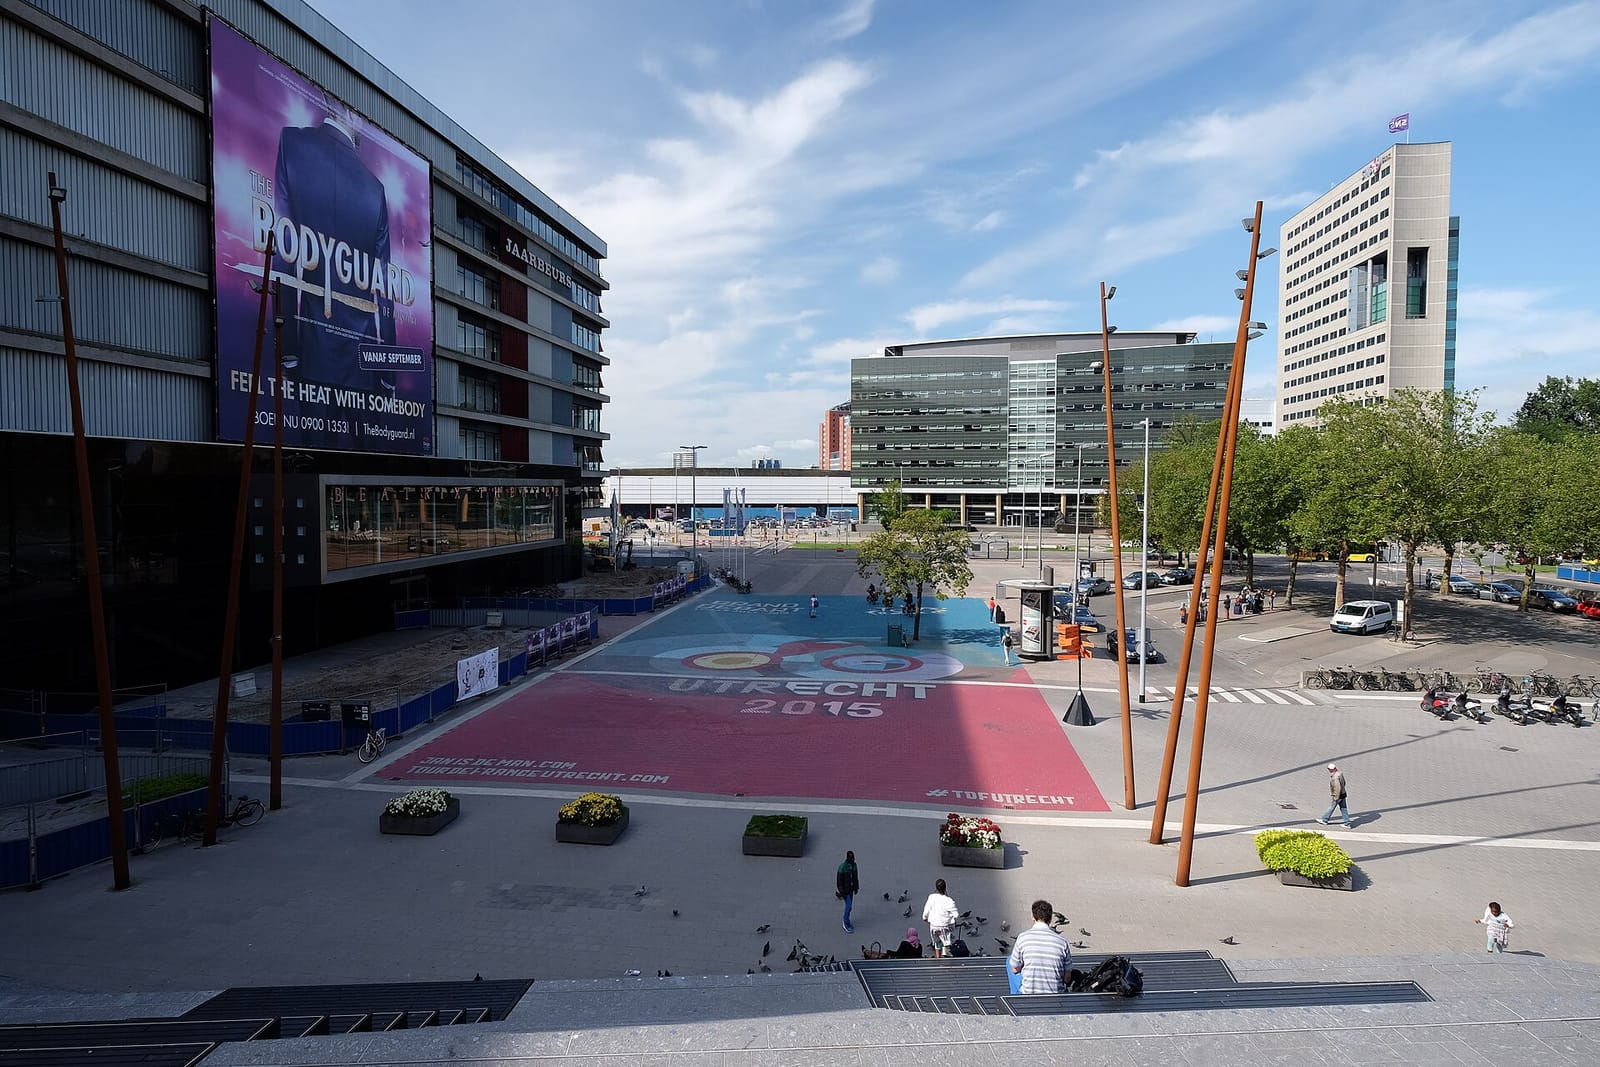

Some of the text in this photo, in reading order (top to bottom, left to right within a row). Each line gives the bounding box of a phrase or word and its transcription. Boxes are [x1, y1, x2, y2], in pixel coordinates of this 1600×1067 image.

[249, 170, 273, 199] THE
[252, 196, 416, 319] BODYGUARD
[505, 238, 573, 289] JAARBEURS
[362, 351, 422, 364] VANAF SEPTEMBER
[299, 382, 332, 405] HEAT
[334, 388, 366, 410] WITH
[368, 394, 426, 418] SOMEBODY
[283, 414, 298, 429] NU
[301, 416, 325, 431] 0900
[363, 422, 415, 441] TheBodyguard.nl
[334, 486, 462, 503] BEATRIX
[668, 678, 937, 699] UTRECHT
[740, 699, 883, 718] 2015
